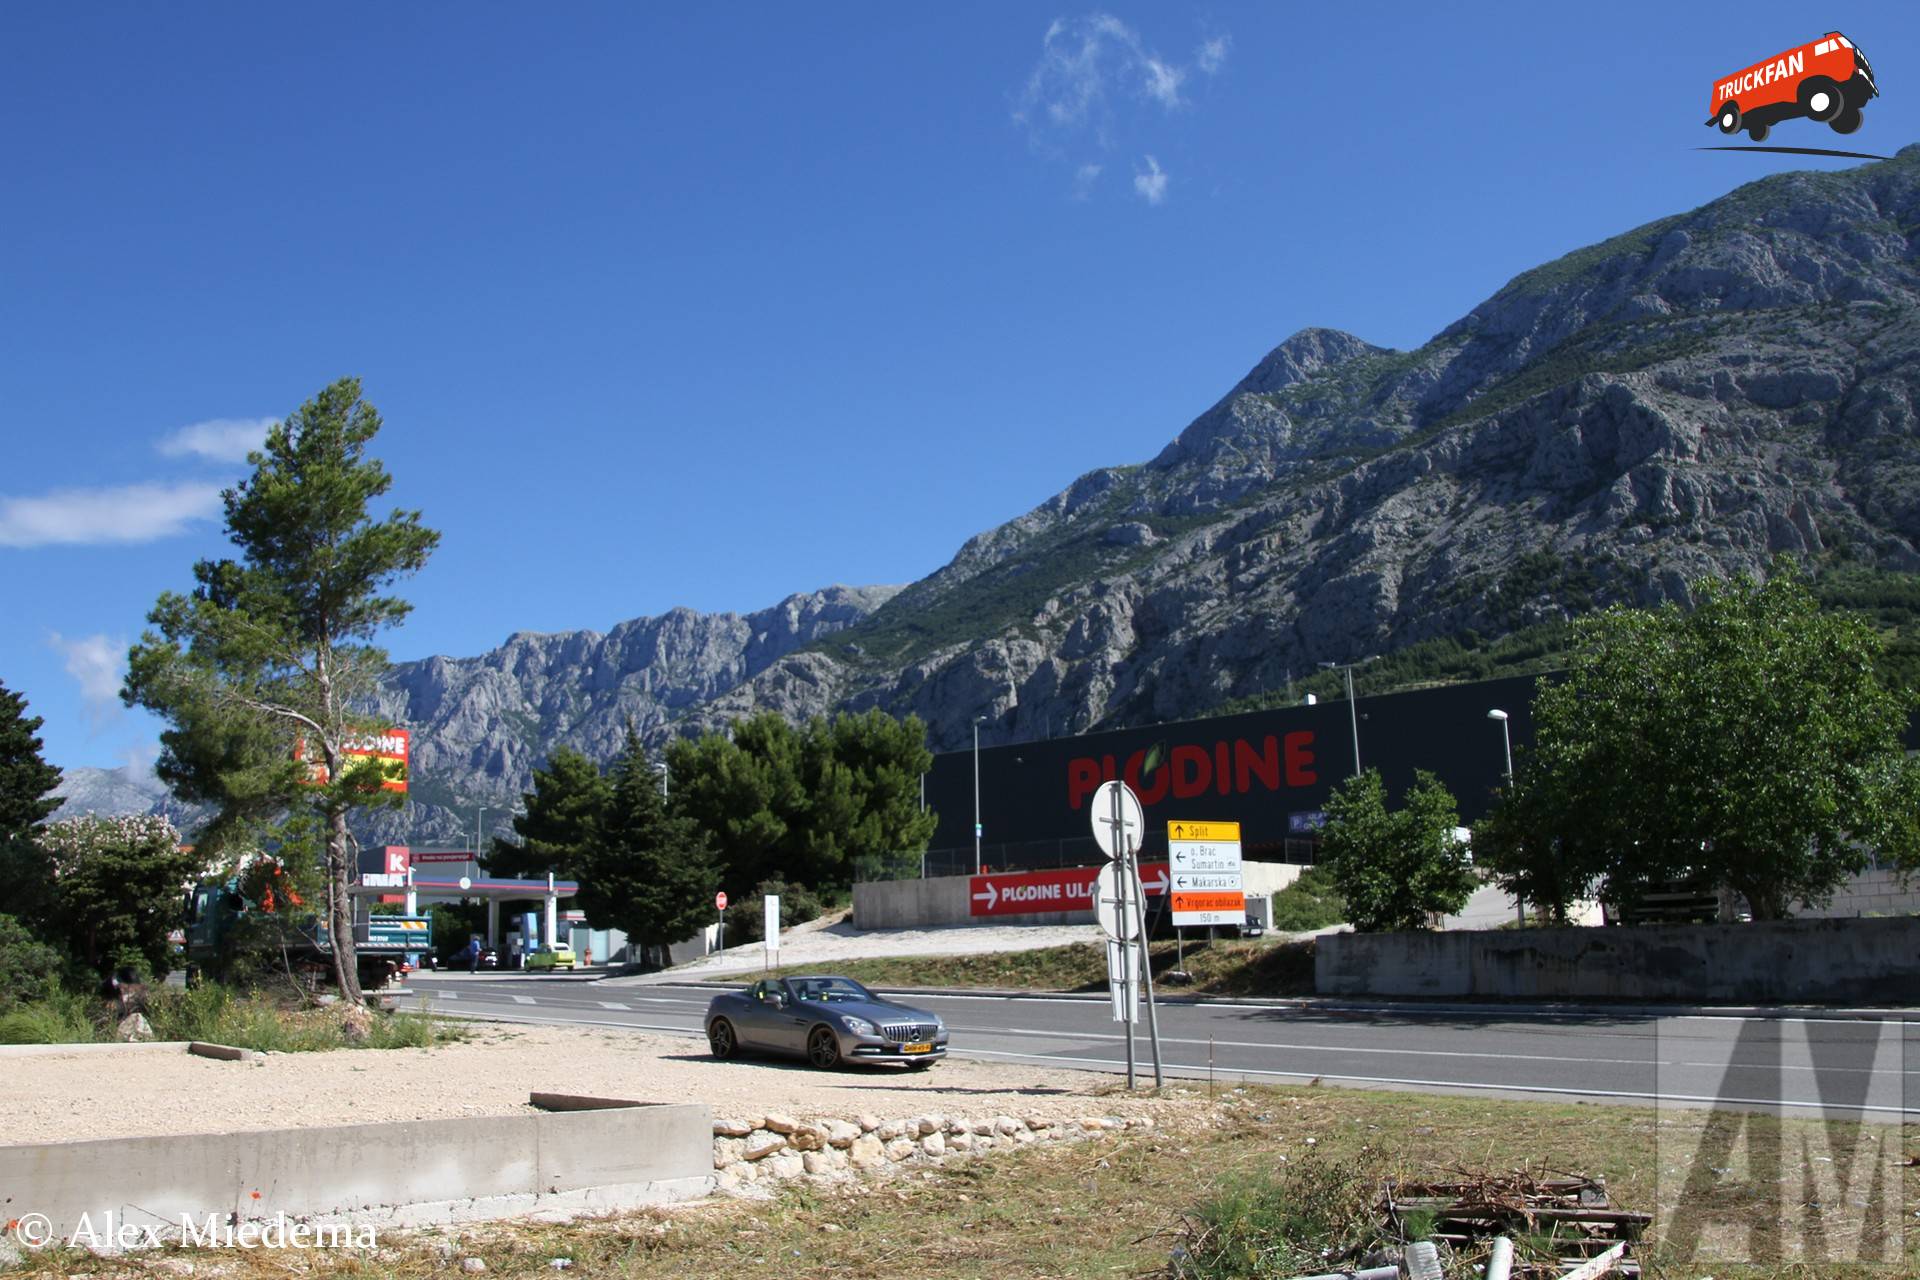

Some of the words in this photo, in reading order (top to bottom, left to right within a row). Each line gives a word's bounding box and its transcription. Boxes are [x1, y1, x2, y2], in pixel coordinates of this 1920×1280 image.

[1189, 825, 1208, 840] Split
[390, 853, 406, 872] K
[1192, 877, 1227, 887] Makarska
[1002, 884, 1061, 902] PLODINE
[1066, 882, 1095, 898] ULA
[1200, 913, 1212, 922] 150
